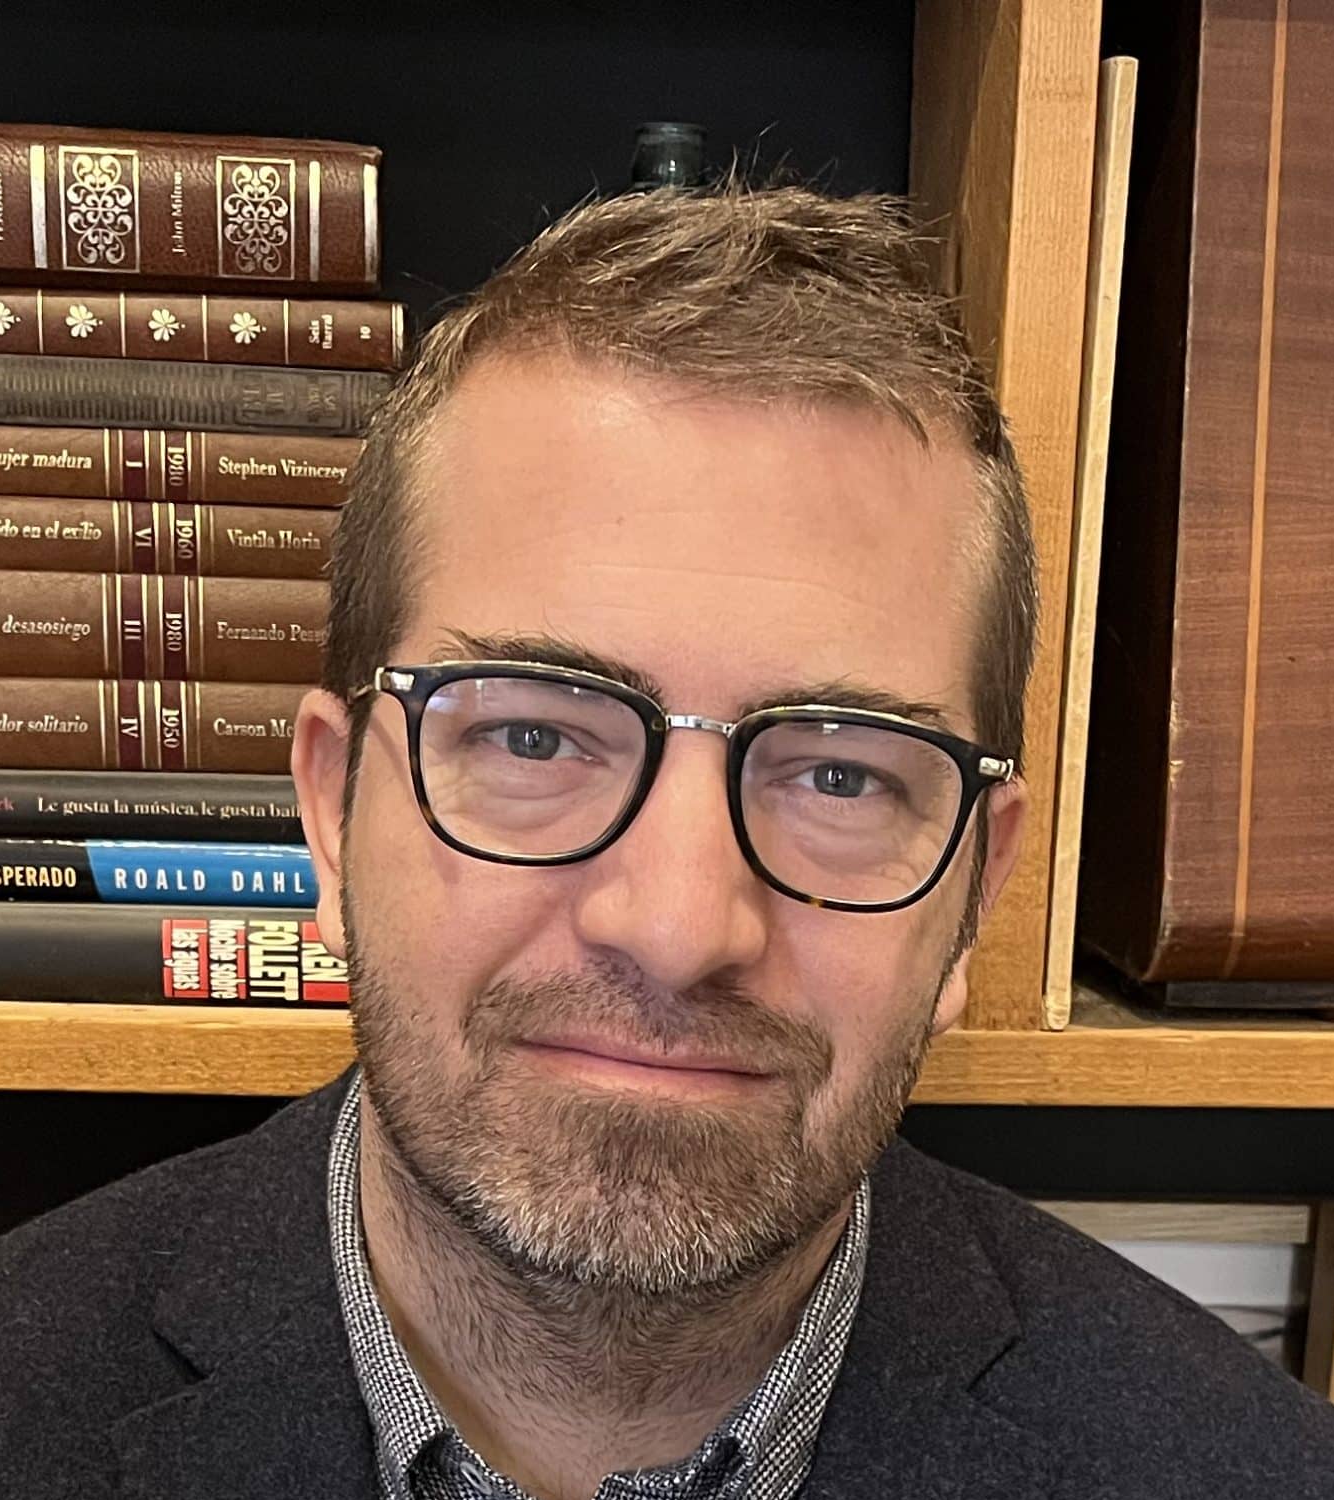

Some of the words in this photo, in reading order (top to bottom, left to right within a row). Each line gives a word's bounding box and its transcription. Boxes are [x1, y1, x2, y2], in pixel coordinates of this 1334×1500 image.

[321, 314, 333, 349] Barral
[32, 449, 92, 469] madura
[167, 446, 185, 487] 1980
[218, 456, 277, 480] Stephen
[280, 458, 348, 484] Vizinczey
[22, 525, 41, 540] en
[45, 520, 60, 540] el
[62, 521, 102, 541] exilio
[175, 519, 194, 560] 1960
[227, 528, 276, 549] Vintila
[279, 530, 322, 551] Horia
[2, 614, 91, 641] desasosiego
[165, 612, 183, 652] 1980
[216, 621, 286, 641] Fernando
[290, 623, 328, 643] Pess
[27, 714, 89, 733] solitario
[120, 716, 139, 738] IV
[162, 708, 180, 748] 1950
[213, 718, 266, 737] Carson
[37, 797, 59, 812] Le
[63, 801, 109, 816] gusta
[114, 799, 130, 814] la
[202, 802, 216, 816] le
[220, 804, 266, 819] gusta
[114, 868, 206, 891] ROALD
[232, 871, 305, 894] DAHL
[172, 928, 206, 949] las
[209, 920, 246, 960] Noche
[164, 950, 200, 990] aguas
[247, 920, 299, 1001] FOLLETT
[210, 963, 245, 999] sobre
